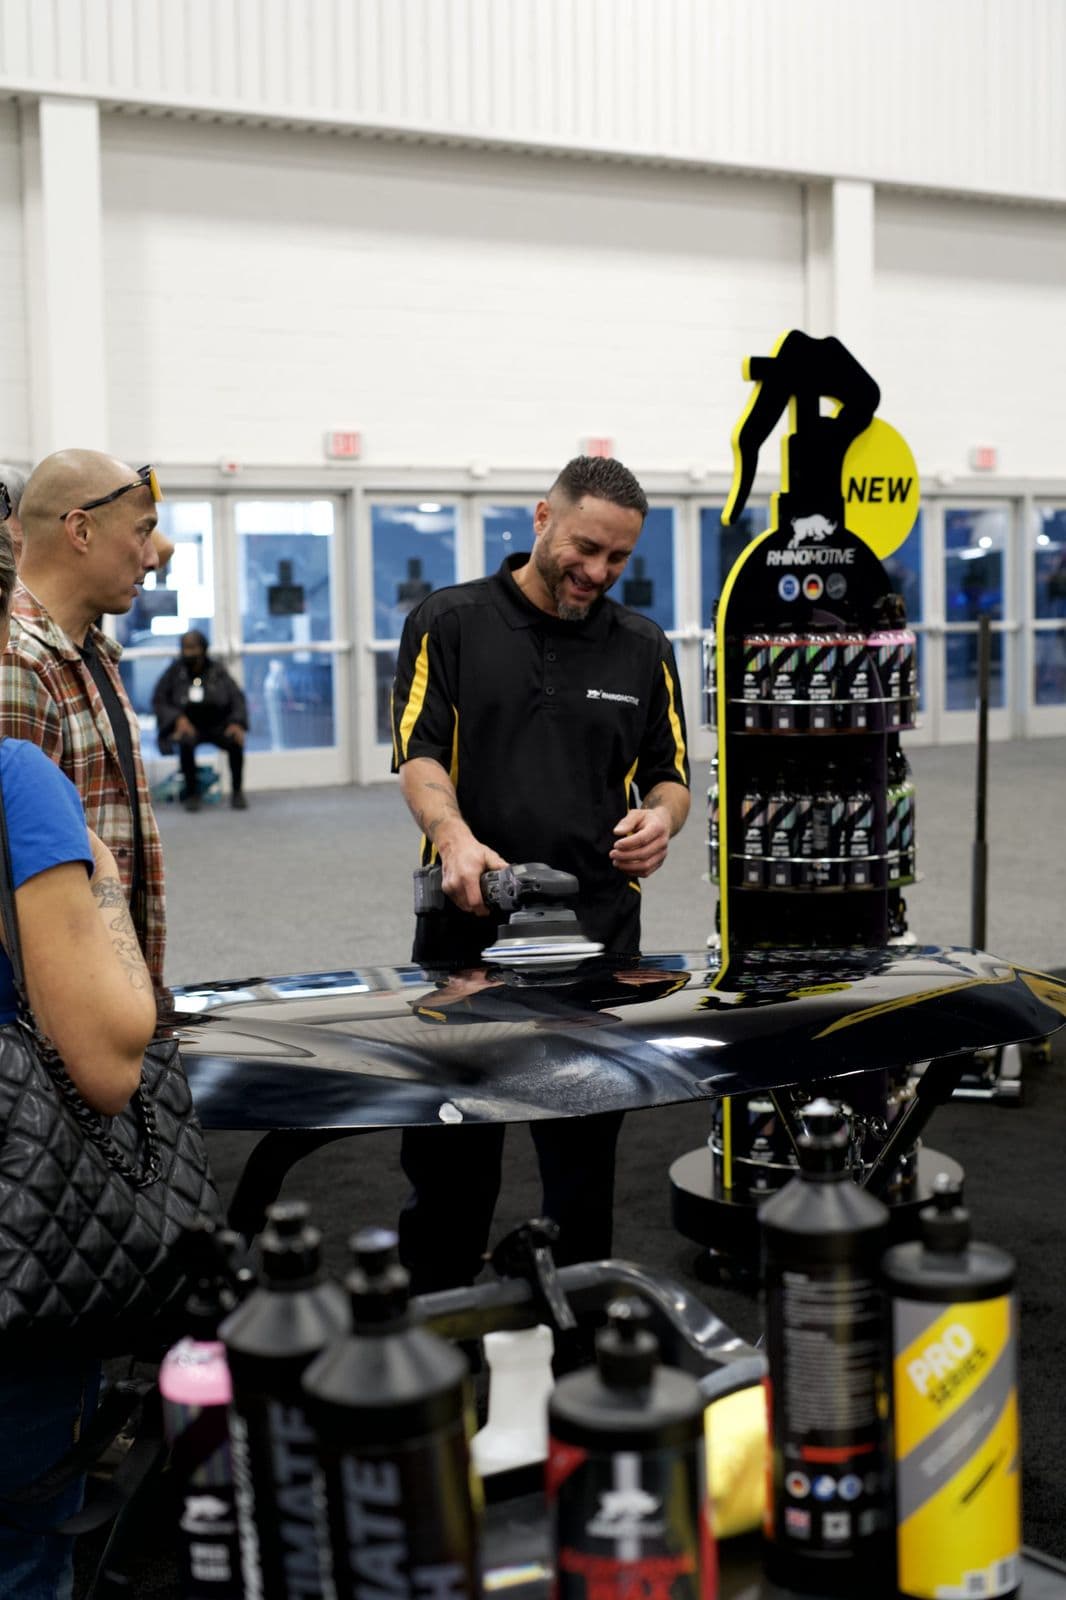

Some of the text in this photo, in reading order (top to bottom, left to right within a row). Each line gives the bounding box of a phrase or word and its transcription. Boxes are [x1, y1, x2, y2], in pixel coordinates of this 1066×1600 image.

[847, 476, 912, 503] NEW
[766, 548, 856, 566] RHINOMOTIVE
[907, 1323, 974, 1396] PRO
